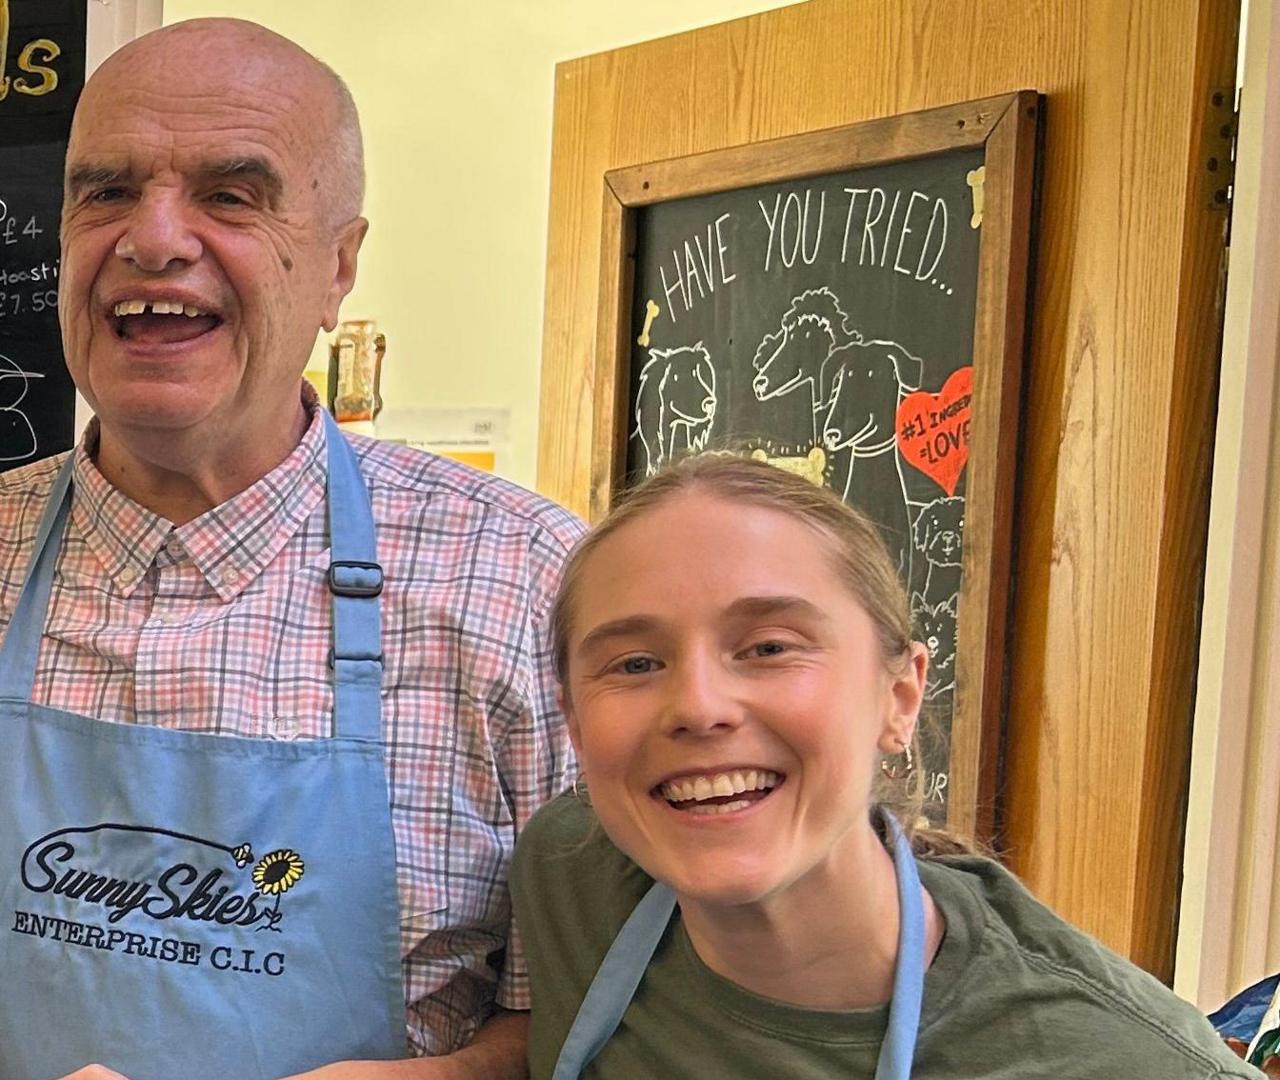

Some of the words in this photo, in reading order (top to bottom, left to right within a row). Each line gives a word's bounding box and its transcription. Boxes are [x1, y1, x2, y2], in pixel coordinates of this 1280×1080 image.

[659, 213, 737, 322] HAVE
[757, 188, 826, 272] YOU
[842, 187, 954, 295] TRIED...
[901, 413, 927, 442] #1
[21, 840, 264, 926] SunnySkies
[11, 911, 201, 966] ENTERPRISE
[210, 946, 286, 977] C.I.C
